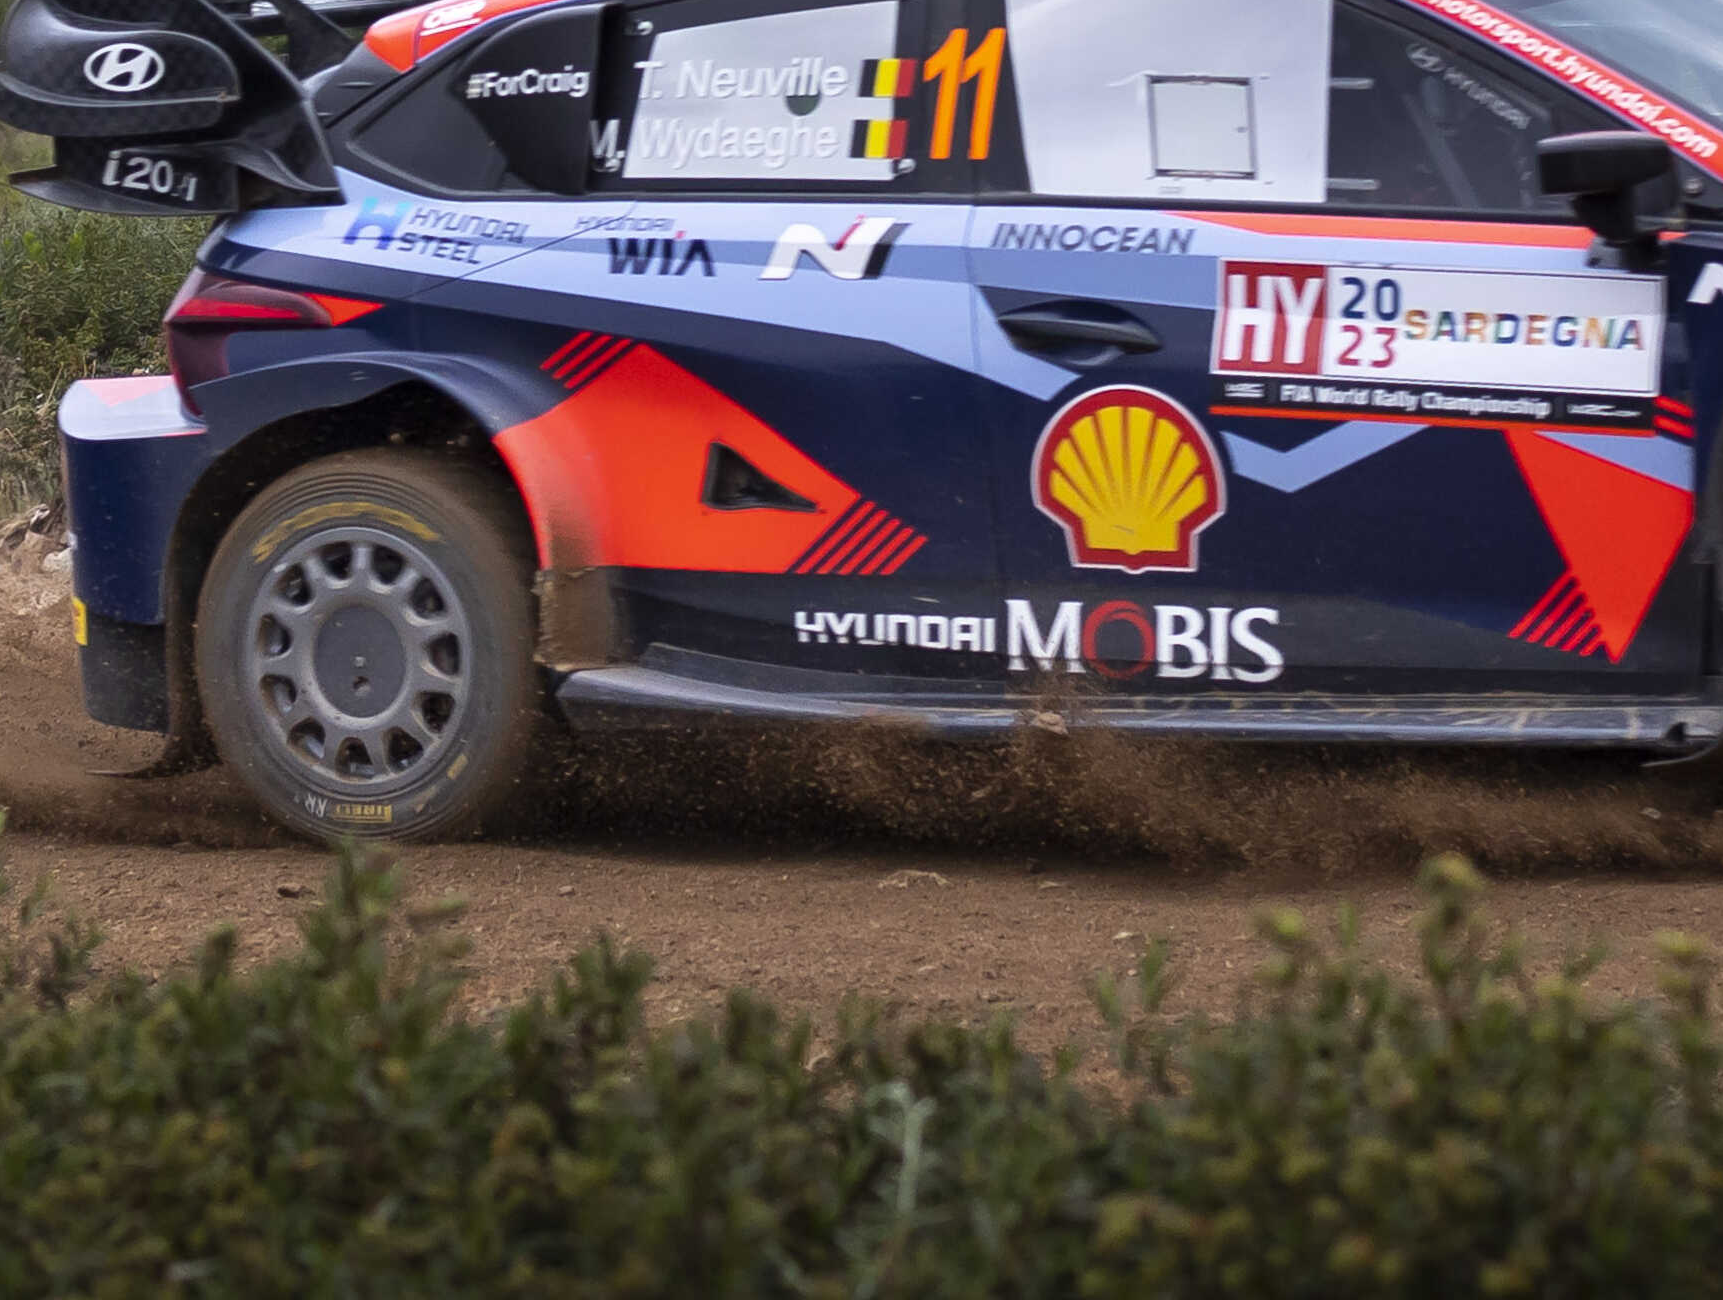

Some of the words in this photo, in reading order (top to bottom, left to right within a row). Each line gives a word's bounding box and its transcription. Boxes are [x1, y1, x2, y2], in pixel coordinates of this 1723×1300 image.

[466, 65, 590, 98] #ForCraig
[634, 61, 665, 99] T.
[676, 57, 849, 98] Neuville
[923, 28, 1006, 160] 11
[638, 117, 840, 170] Wydaeghe
[409, 207, 530, 243] HYUNDAI
[990, 223, 1197, 254] INNOCEAN
[397, 232, 481, 265] STEEL
[608, 230, 716, 277] WIA
[1222, 274, 1324, 364] HY
[1341, 277, 1401, 320] 20
[1338, 325, 1399, 368] 23
[1402, 309, 1644, 350] SARDEGNA
[1280, 384, 1313, 402] FIA
[1315, 387, 1369, 405] World
[1372, 389, 1419, 411] Rally
[1421, 392, 1551, 419] Championship
[793, 610, 996, 653] HYUNDAI
[1005, 599, 1283, 684] MOBIS
